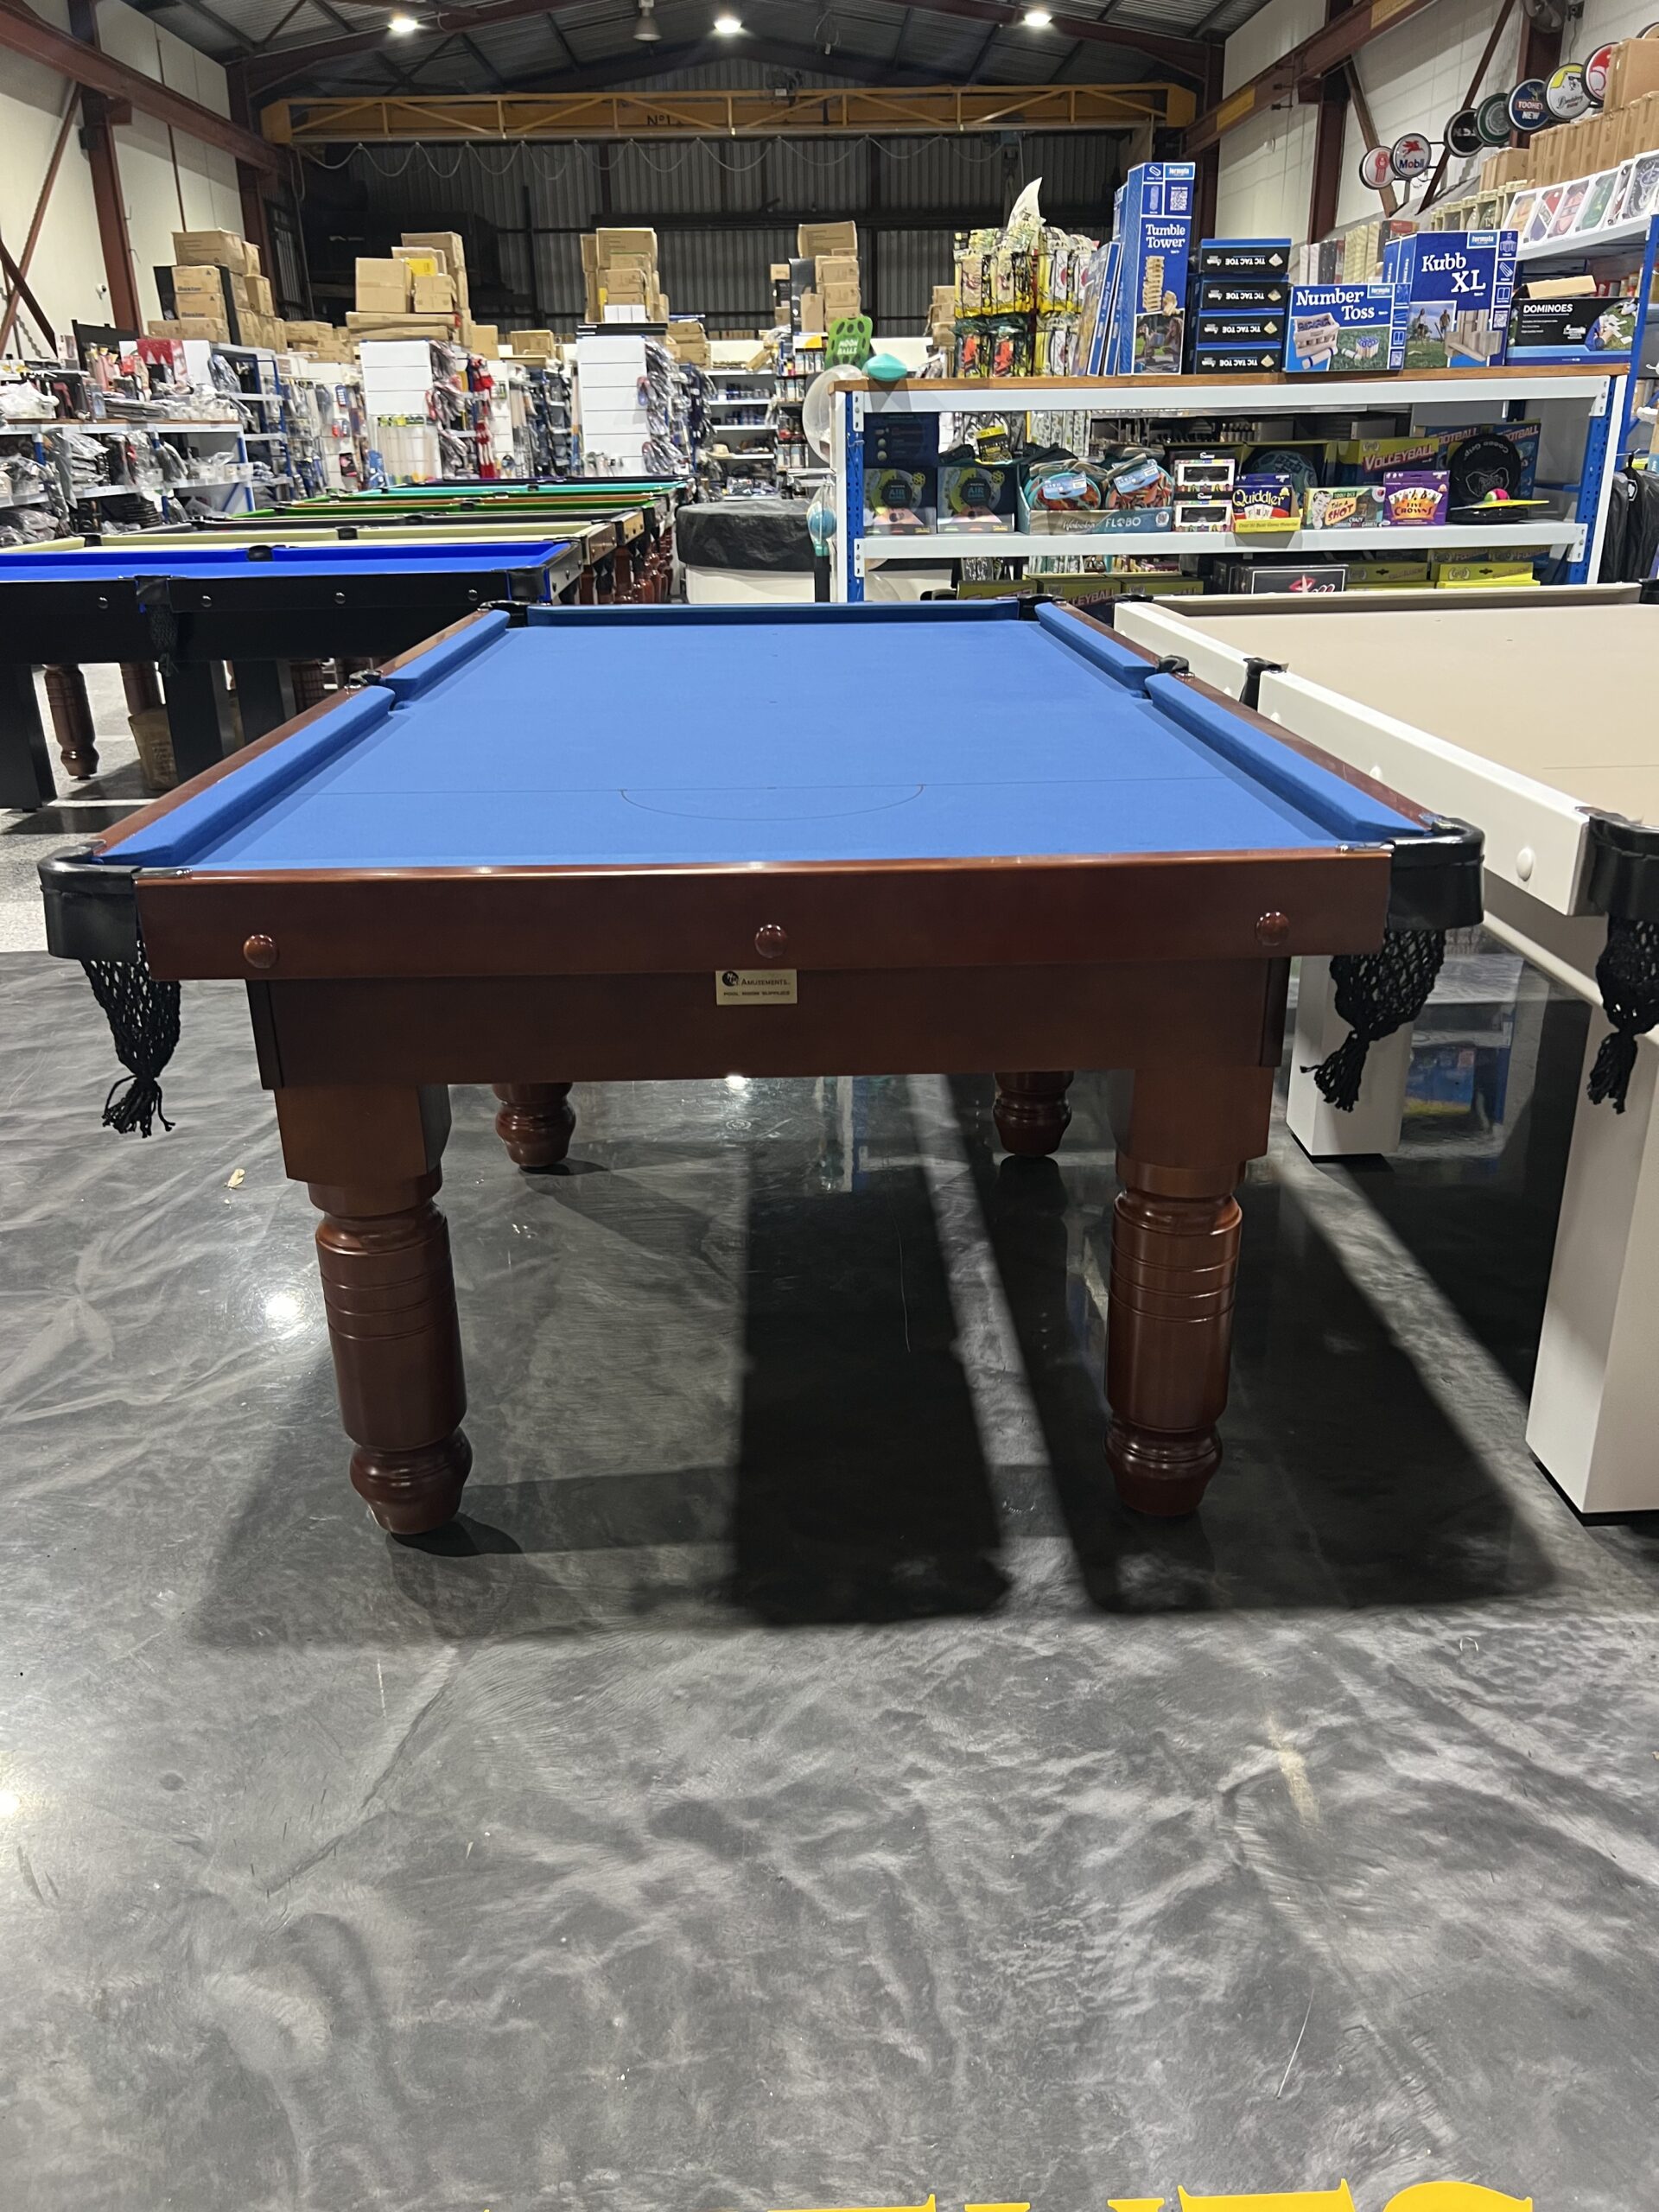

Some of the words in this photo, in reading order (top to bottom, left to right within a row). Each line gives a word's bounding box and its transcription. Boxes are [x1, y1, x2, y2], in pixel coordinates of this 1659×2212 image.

[1522, 111, 1540, 119] NEW
[1399, 158, 1425, 168] Mobil
[1145, 224, 1185, 236] Tumble
[1146, 236, 1185, 249] Tower
[1421, 252, 1467, 272] Kubb
[1451, 269, 1486, 293] XL
[1296, 288, 1364, 306] Number
[1341, 305, 1375, 321] Toss
[1522, 303, 1573, 314] DOMINOES
[1364, 444, 1434, 471] VOLLEYBALL
[1232, 488, 1284, 506] Quiddler
[1328, 504, 1354, 521] SHOT
[1395, 506, 1433, 516] CROWNS
